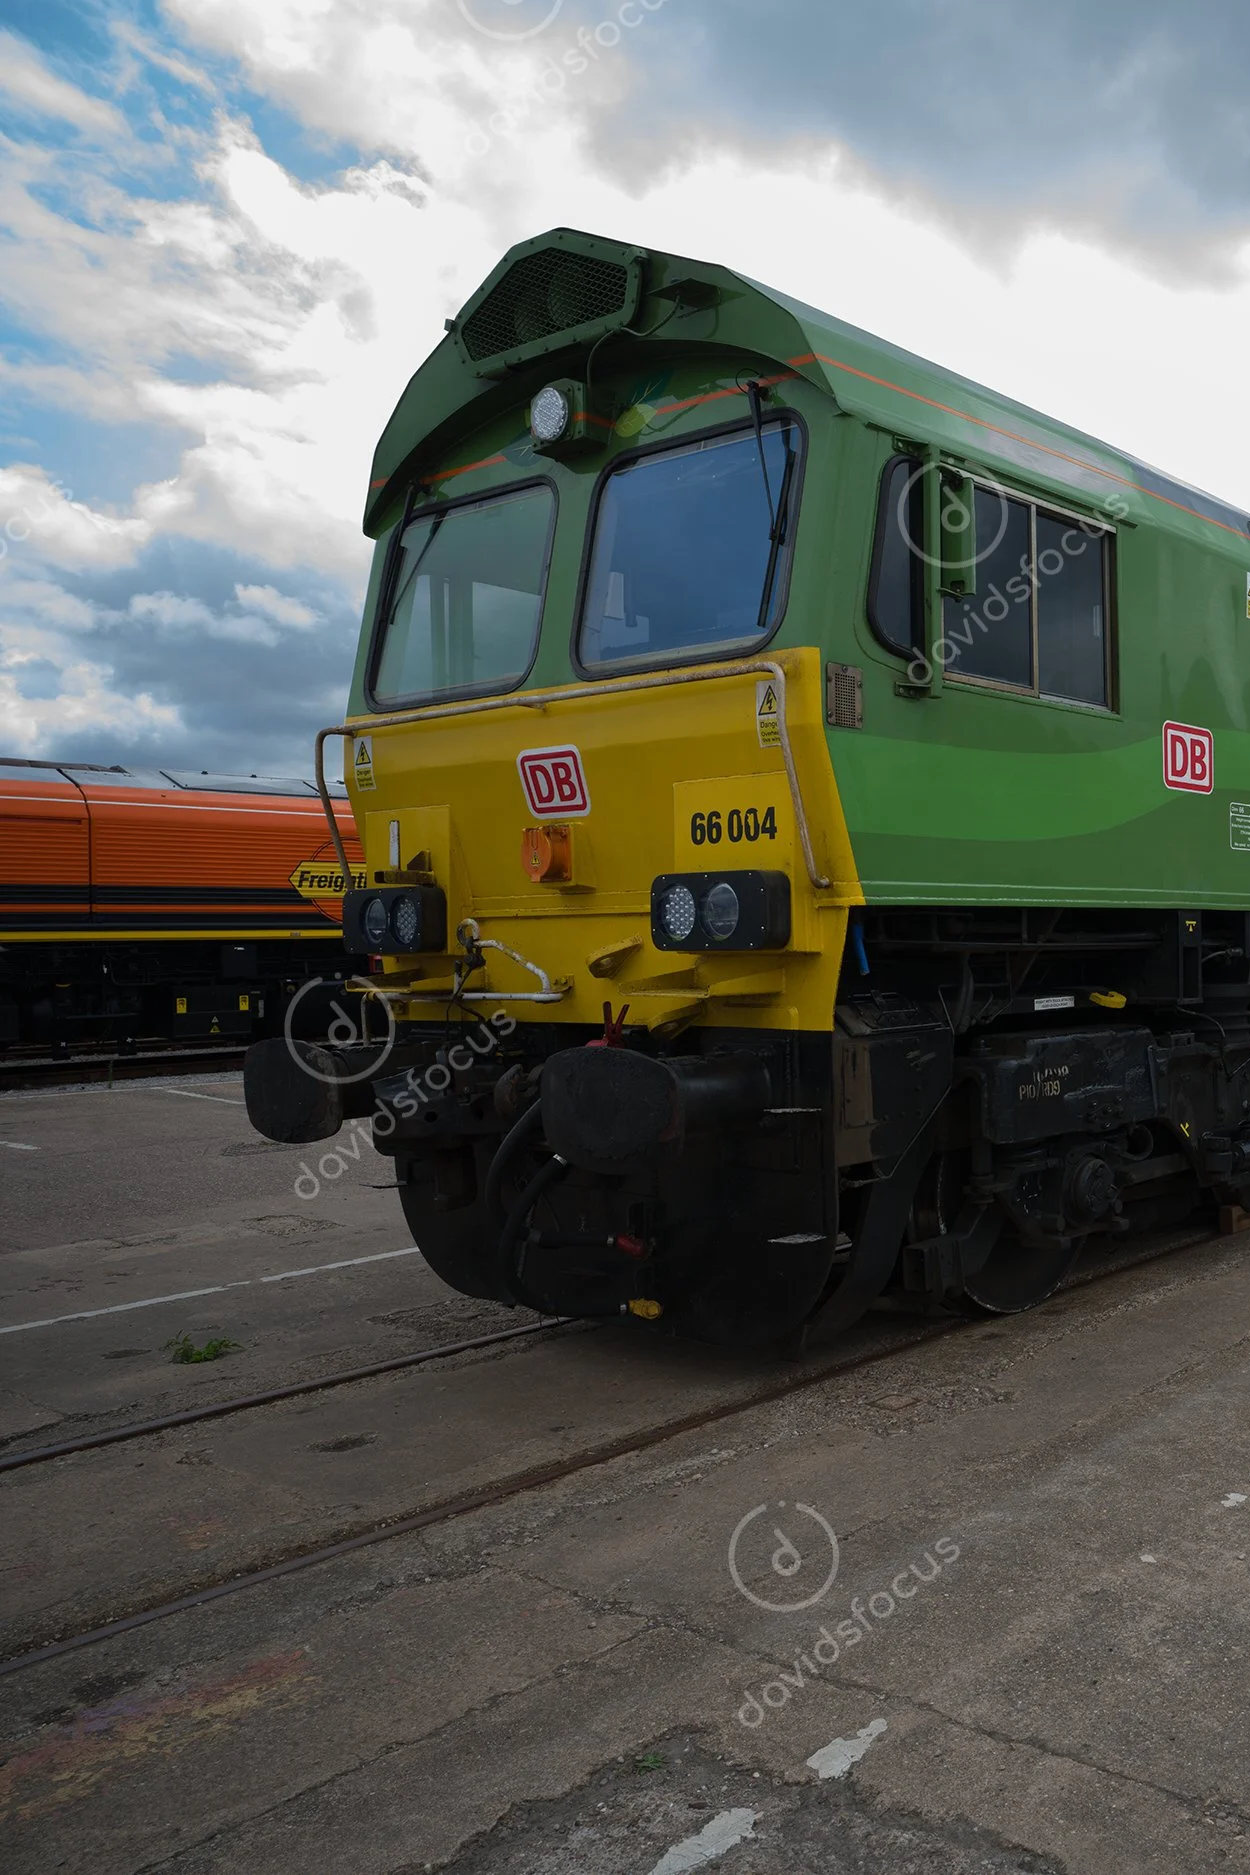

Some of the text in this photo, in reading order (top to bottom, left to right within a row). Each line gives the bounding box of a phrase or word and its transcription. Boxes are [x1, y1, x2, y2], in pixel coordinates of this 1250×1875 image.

[760, 721, 777, 729] Dang
[1171, 734, 1207, 780] DB
[529, 762, 577, 804] DB
[691, 806, 777, 846] 66 004
